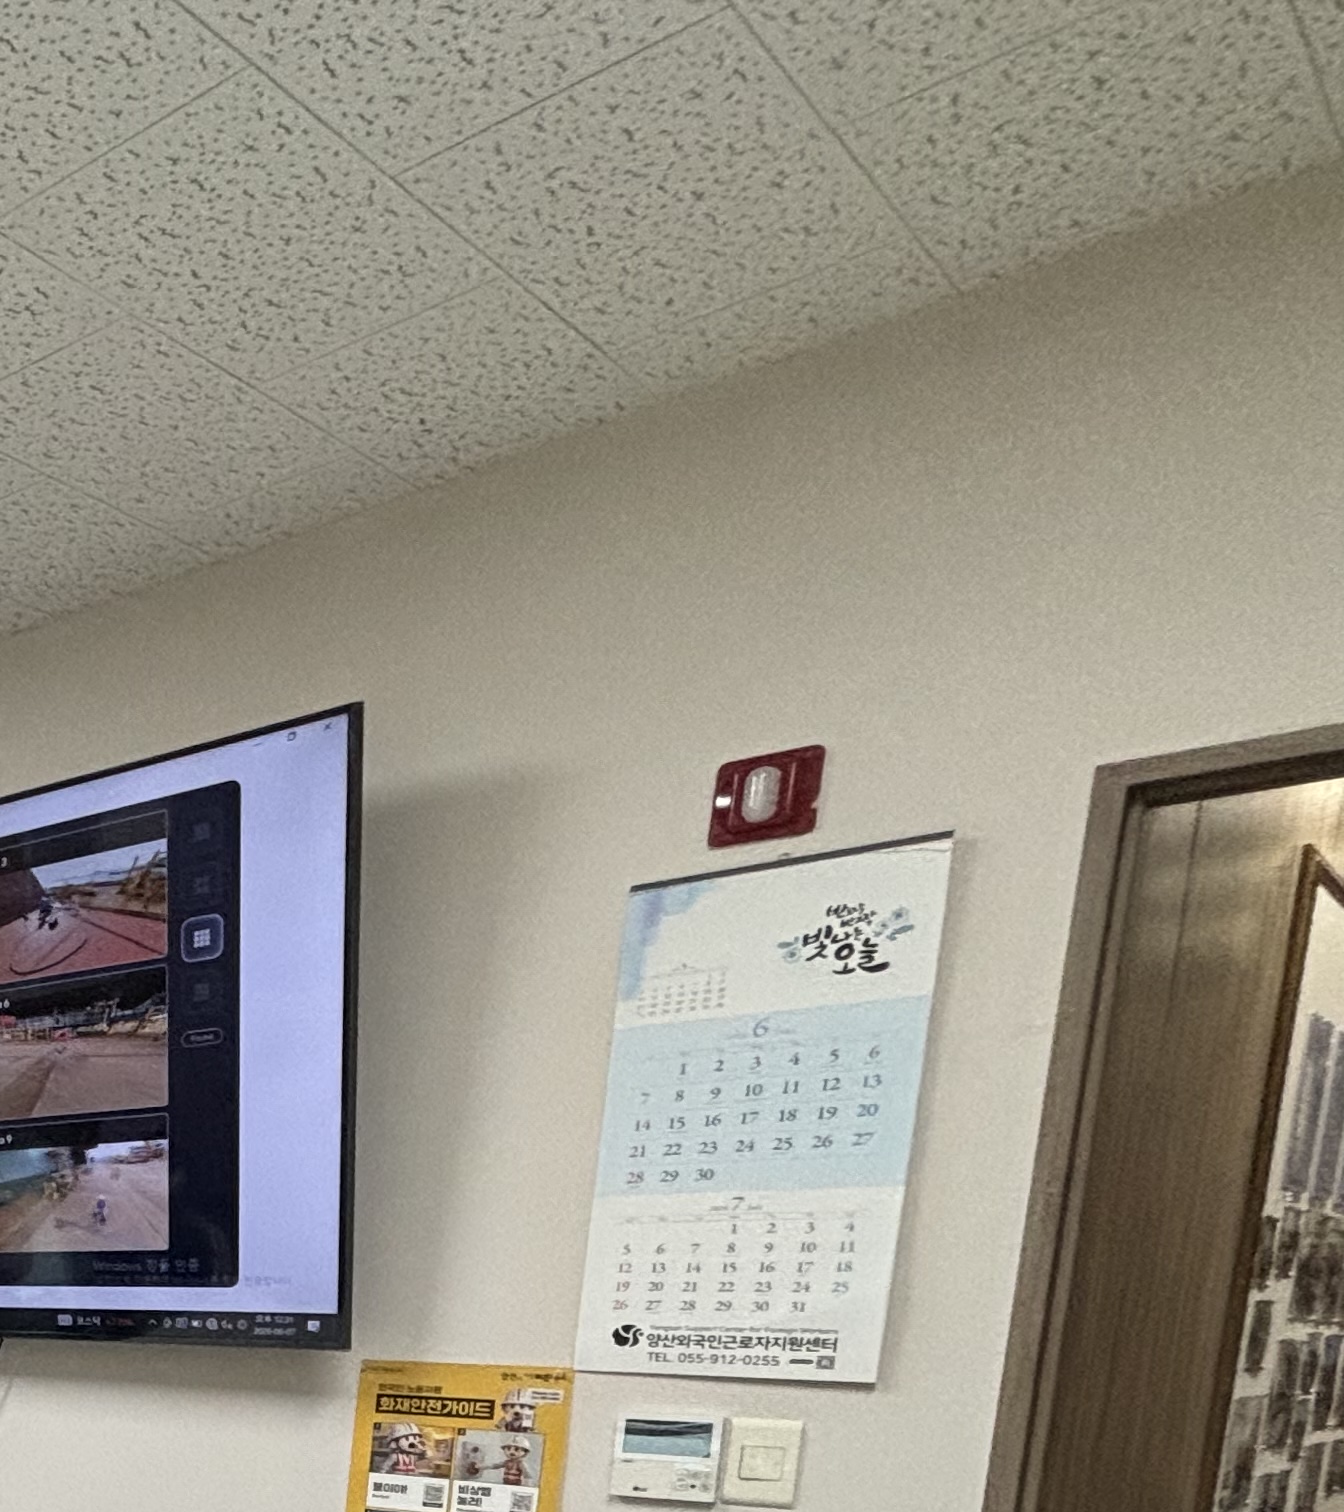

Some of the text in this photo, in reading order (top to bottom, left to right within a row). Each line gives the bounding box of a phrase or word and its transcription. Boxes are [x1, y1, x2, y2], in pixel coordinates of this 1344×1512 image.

[0, 857, 8, 868] 3
[802, 924, 864, 962] 빛나는
[832, 937, 891, 975] 오늘
[3, 998, 10, 1008] 6
[752, 1019, 768, 1038] 6
[679, 1045, 880, 1076] 1 2 3 4 5 6
[675, 1089, 684, 1102] 8
[711, 1087, 721, 1100] 9
[745, 1084, 762, 1097] 10
[782, 1080, 800, 1094] 11
[822, 1077, 841, 1091] 12
[863, 1074, 882, 1089] 13
[669, 1117, 686, 1129] 15
[705, 1115, 721, 1127] 16
[741, 1111, 759, 1125] 17
[779, 1109, 797, 1122] 18
[818, 1106, 838, 1120] 19
[856, 1104, 879, 1118] 20
[6, 1135, 13, 1145] 9
[630, 1132, 874, 1158] 21 22 23 24 25 26 27
[627, 1168, 714, 1184] 28 29 30
[732, 1196, 744, 1211] 7
[731, 1223, 737, 1234] 1
[767, 1223, 777, 1234] 2
[805, 1222, 815, 1233] 3
[623, 1241, 855, 1255] 5 6 7 8 9 10 11
[618, 1263, 632, 1273] 12
[651, 1263, 666, 1273] 13
[686, 1262, 701, 1273] 14
[722, 1262, 737, 1273] 15
[759, 1262, 775, 1273] 16
[836, 1261, 853, 1272] 18
[616, 1282, 850, 1293] 19 20 21 22 23 24 25
[645, 1301, 662, 1311] 27
[679, 1301, 696, 1311] 28
[715, 1301, 732, 1311] 29
[751, 1301, 769, 1312] 30
[790, 1302, 806, 1312] 31
[646, 1333, 838, 1353] 양산외국인근로자지원센터
[678, 1352, 780, 1366] 055-912-0255
[378, 1396, 492, 1417] 화재안전가이드
